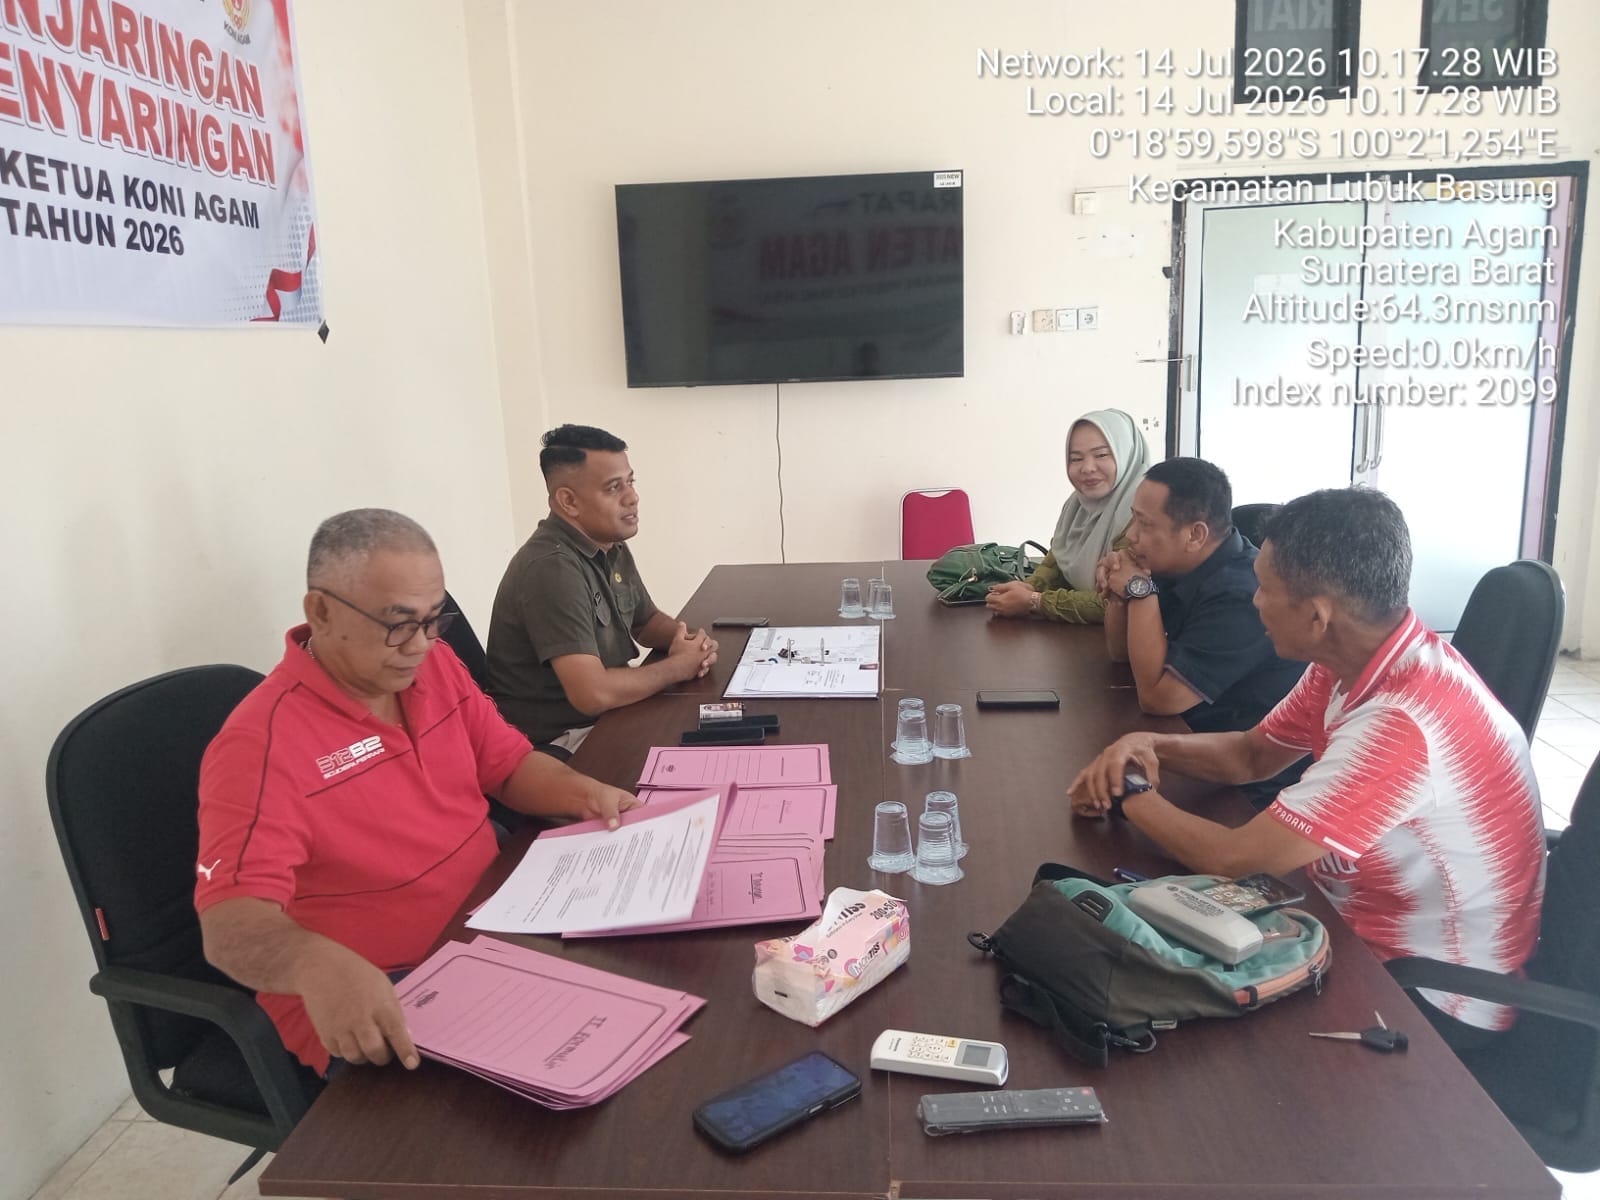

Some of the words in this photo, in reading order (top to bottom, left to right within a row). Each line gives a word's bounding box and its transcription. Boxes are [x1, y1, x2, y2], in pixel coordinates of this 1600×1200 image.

[0, 149, 115, 203] KETUA
[123, 175, 186, 218] KONI
[194, 191, 260, 229] AGAM
[0, 197, 117, 248] TAHUN
[123, 218, 184, 256] 2026
